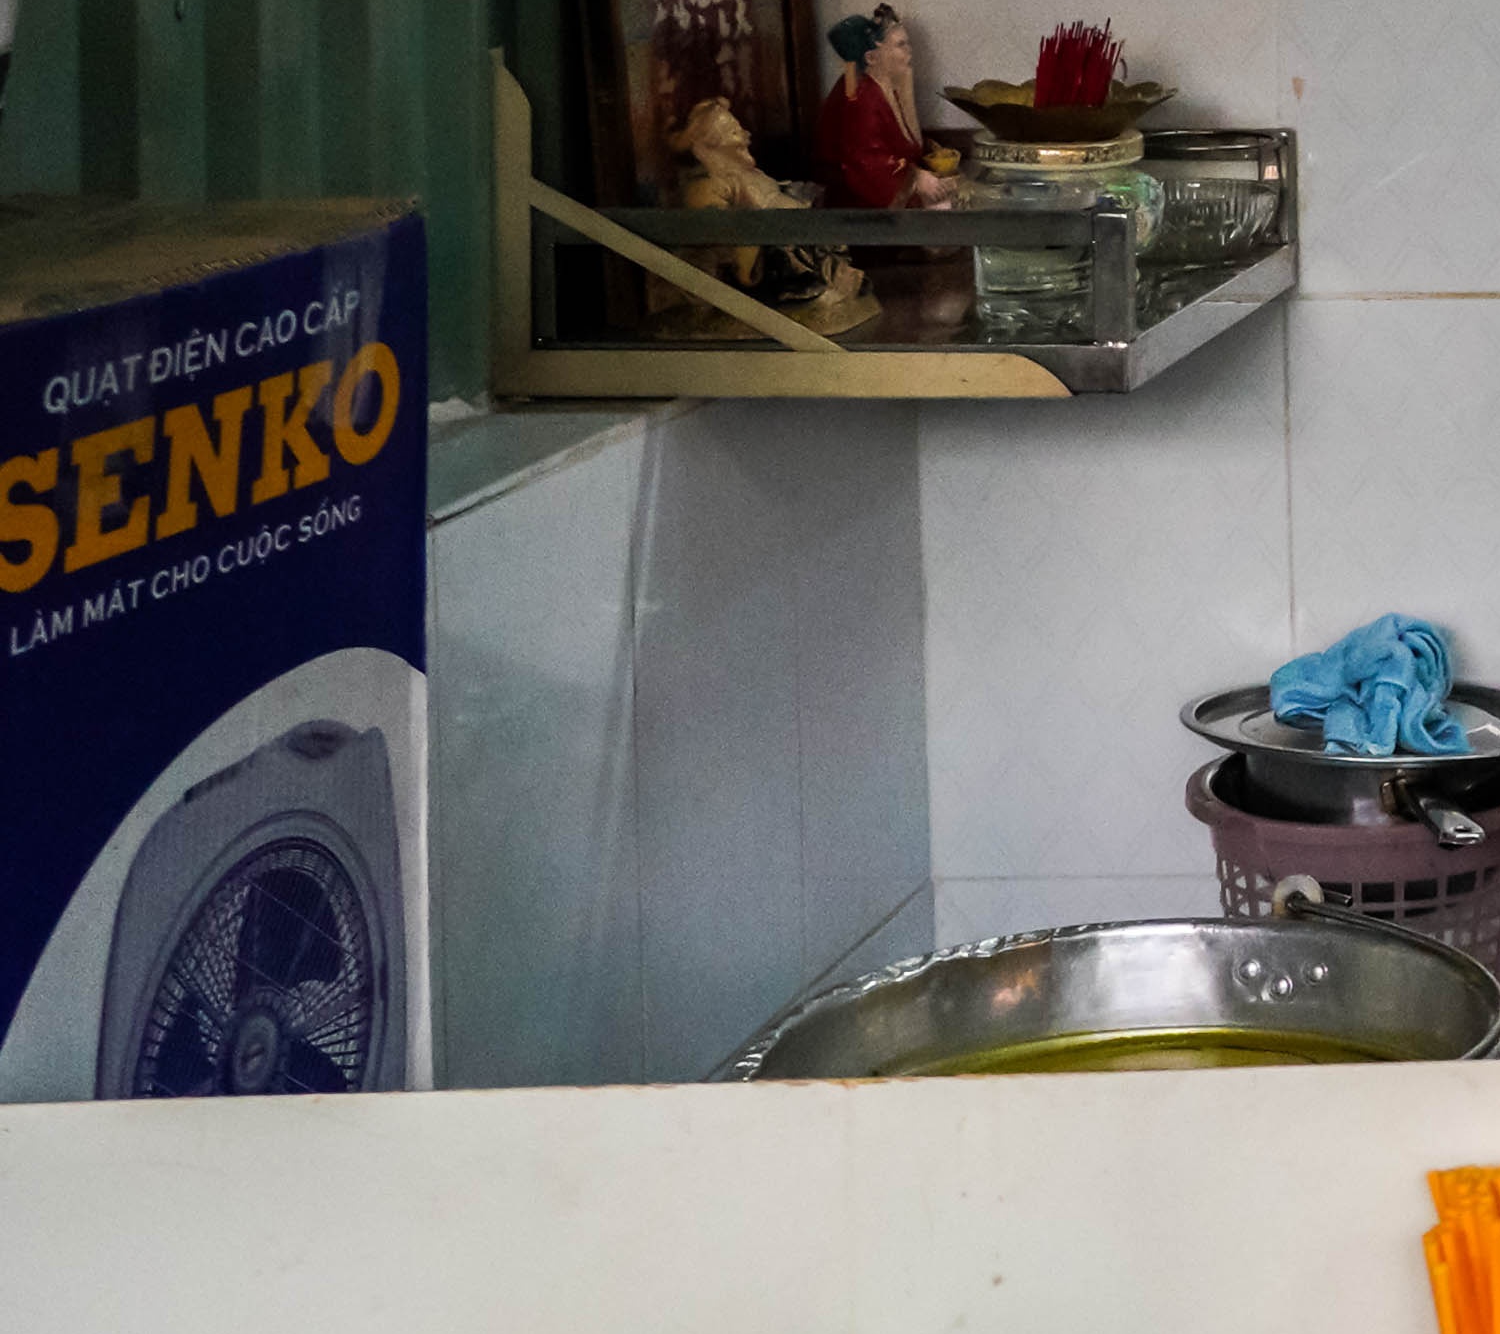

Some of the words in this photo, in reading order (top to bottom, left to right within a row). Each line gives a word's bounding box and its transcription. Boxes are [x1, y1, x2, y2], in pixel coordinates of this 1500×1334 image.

[43, 354, 143, 415] QUẠT
[148, 327, 229, 383] ĐIỆN
[233, 309, 298, 359] CAO
[304, 285, 362, 337] CẤP
[0, 341, 401, 594] SENKO
[9, 604, 75, 657] LÀM
[151, 556, 211, 601] CHO
[217, 527, 292, 576] CUỘC
[298, 494, 363, 543] SỐNG
